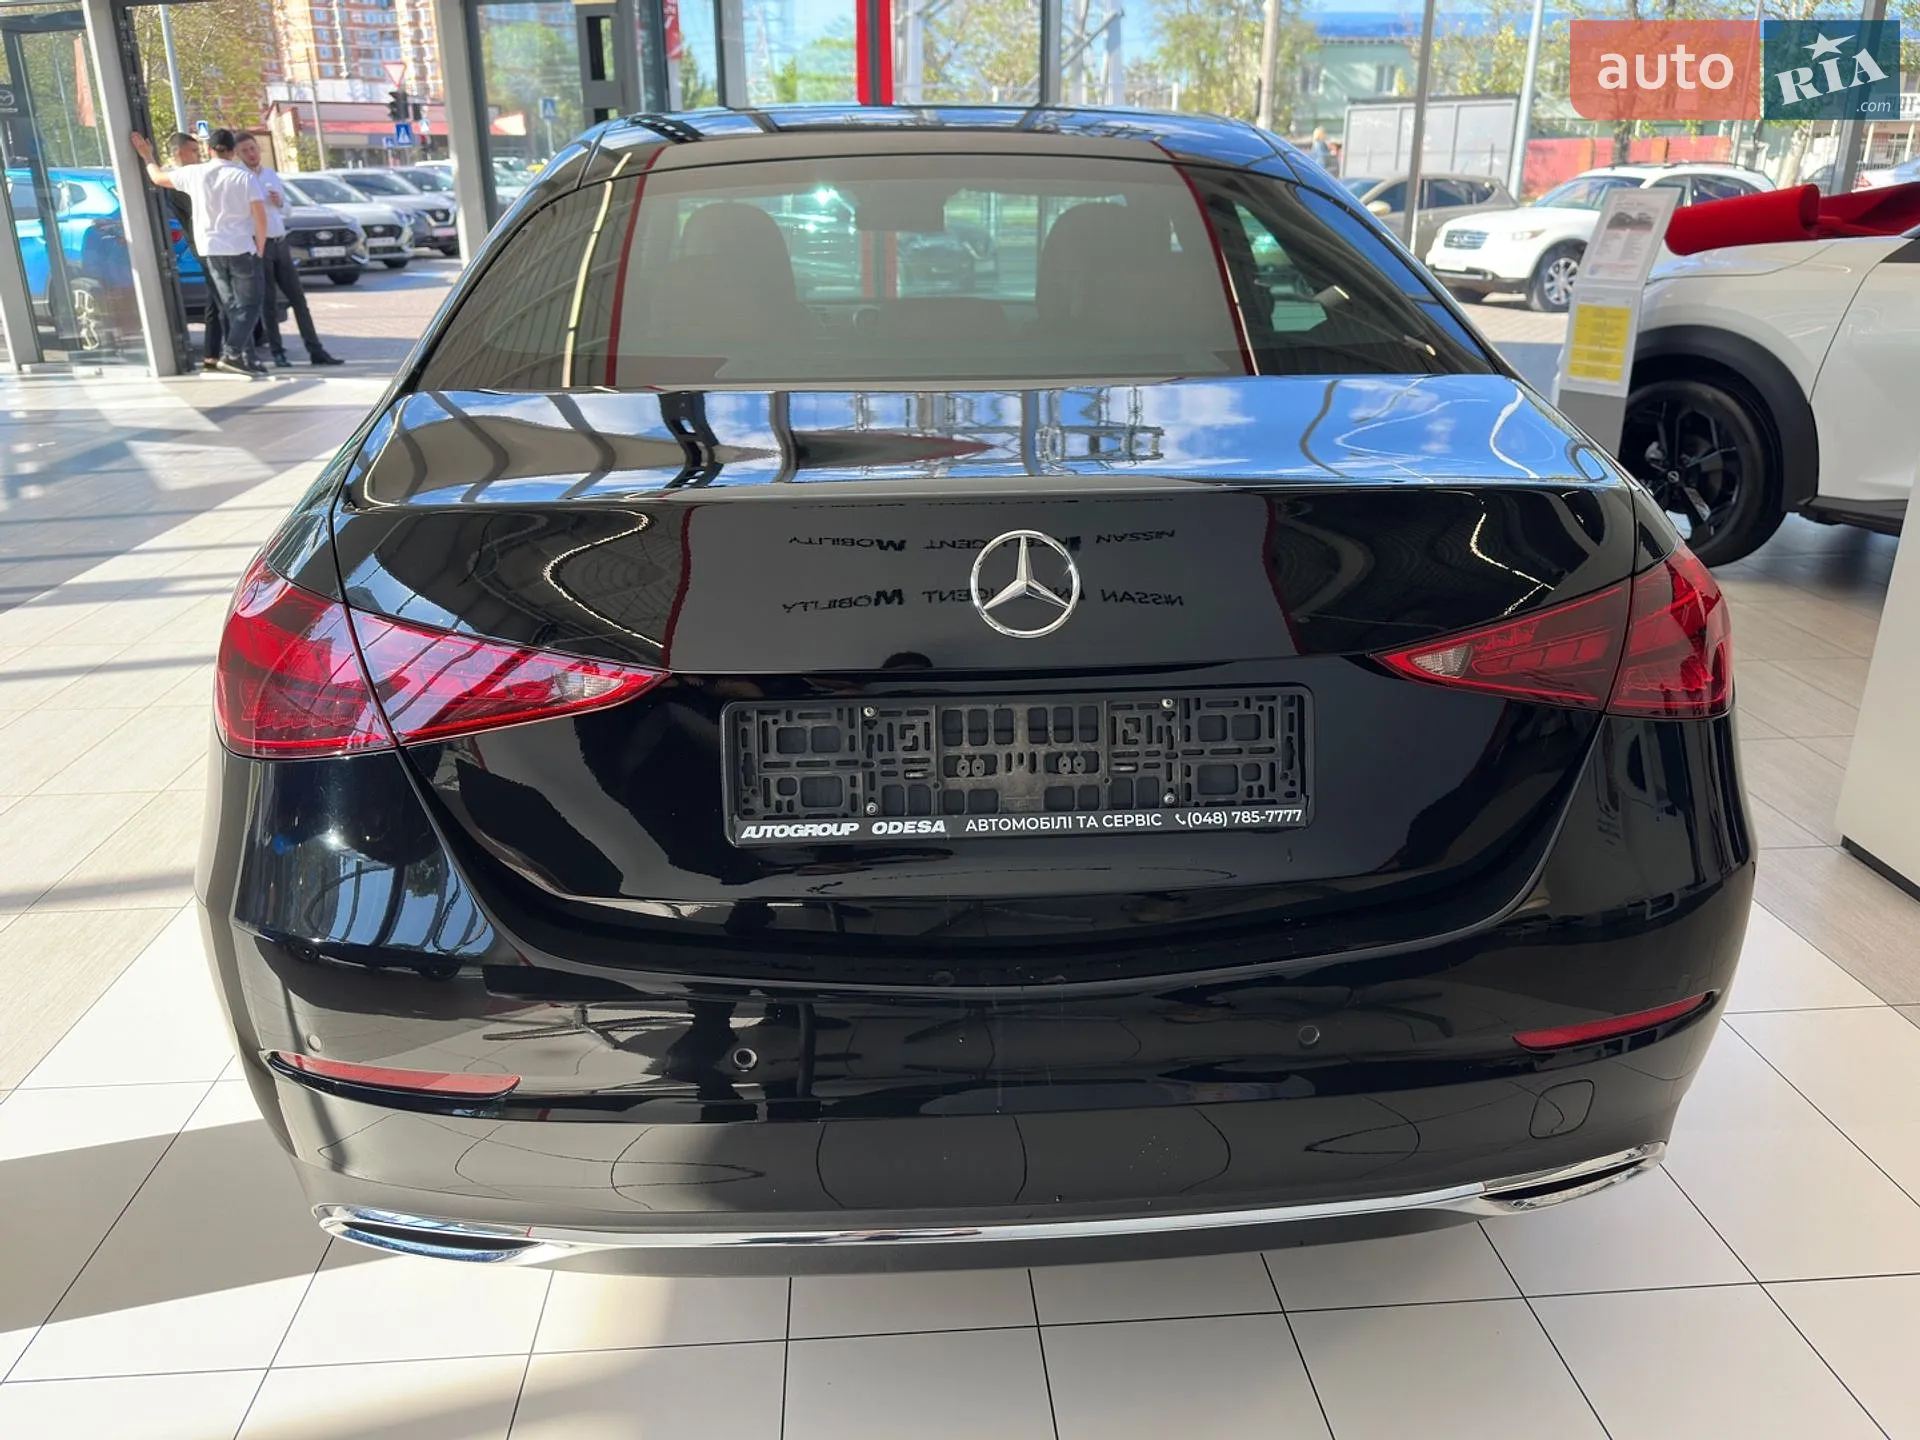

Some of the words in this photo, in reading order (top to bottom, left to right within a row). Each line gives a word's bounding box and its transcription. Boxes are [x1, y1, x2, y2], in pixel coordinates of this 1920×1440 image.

[1096, 529, 1176, 544] NISSAN
[741, 822, 860, 839] AUTOGROUP
[871, 820, 946, 835] ODESA
[965, 816, 1072, 833] АВТОМОБІЛІ
[1076, 815, 1098, 828] ТА
[1102, 813, 1162, 828] СЕРВІС
[1187, 811, 1228, 828] (048)
[1232, 809, 1302, 825] 785-7777
